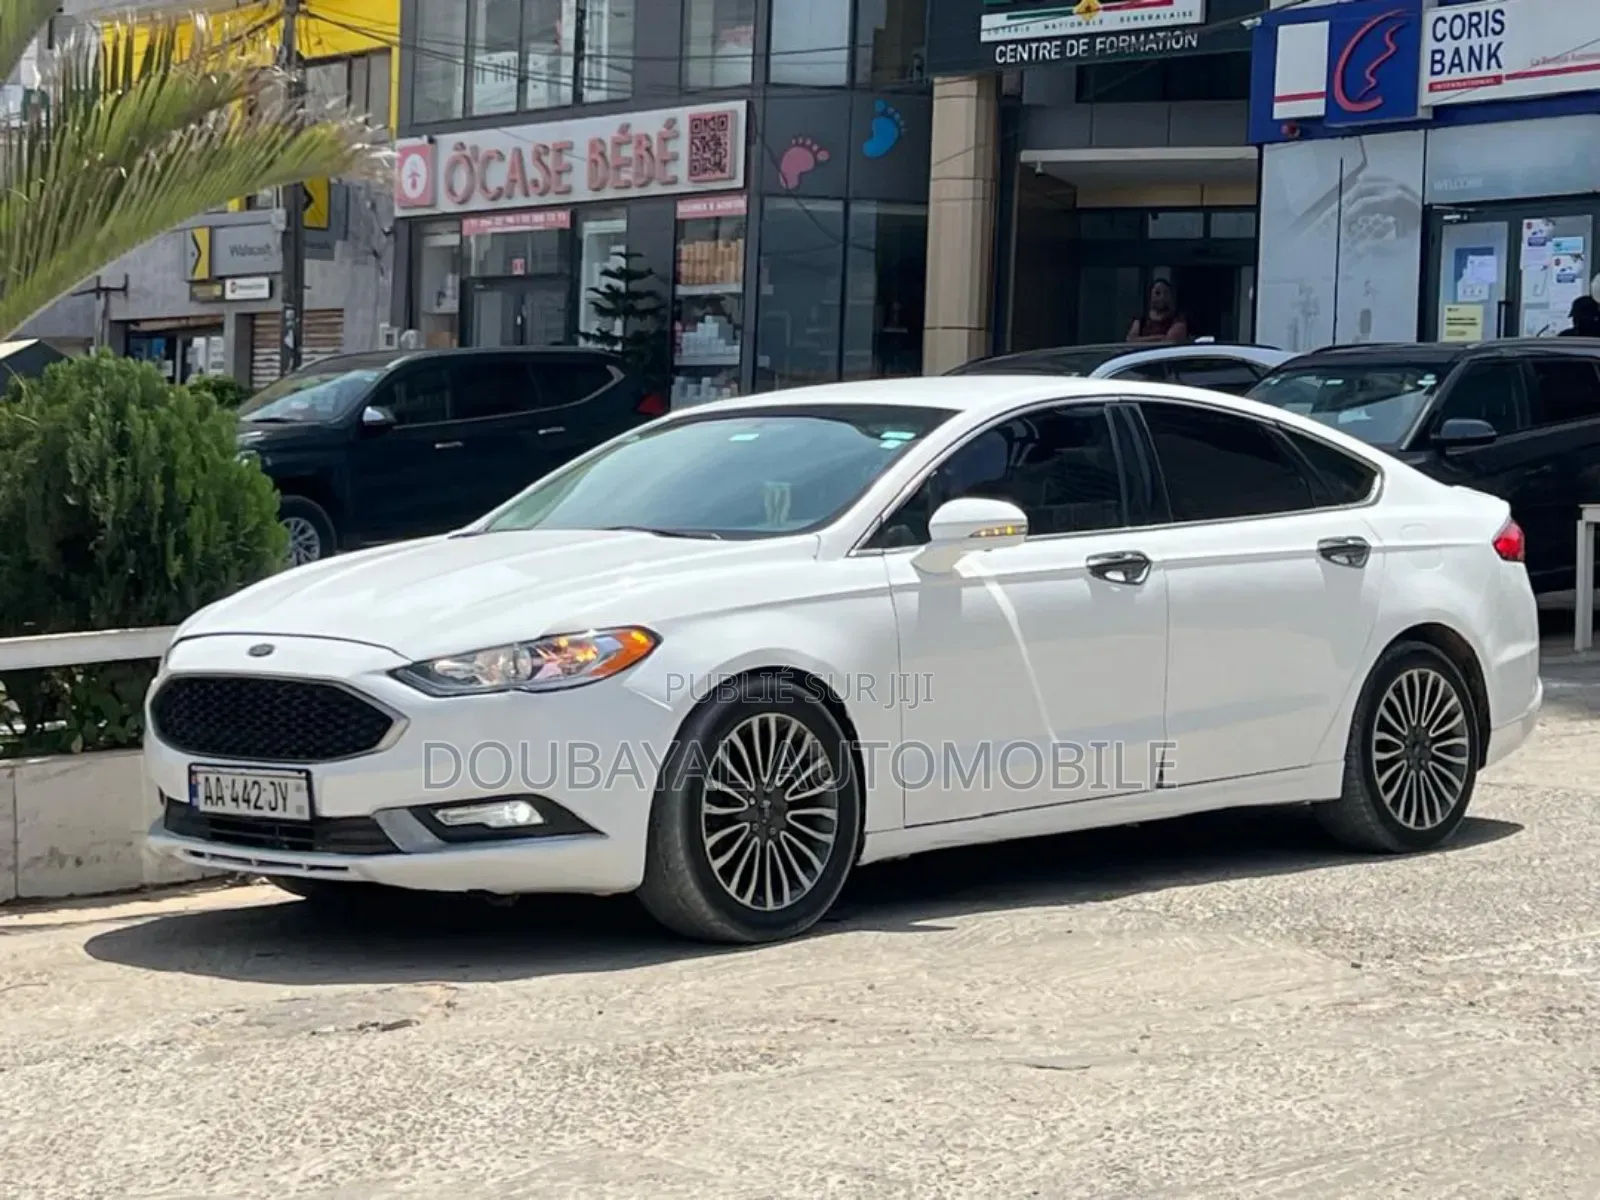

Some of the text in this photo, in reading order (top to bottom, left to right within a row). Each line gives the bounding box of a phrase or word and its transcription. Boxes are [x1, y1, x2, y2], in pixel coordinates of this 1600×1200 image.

[1432, 8, 1505, 43] CORIS
[995, 31, 1199, 64] CENTRE DE FORMATION
[1430, 41, 1504, 76] BANK
[588, 117, 680, 192] BÉBÉ
